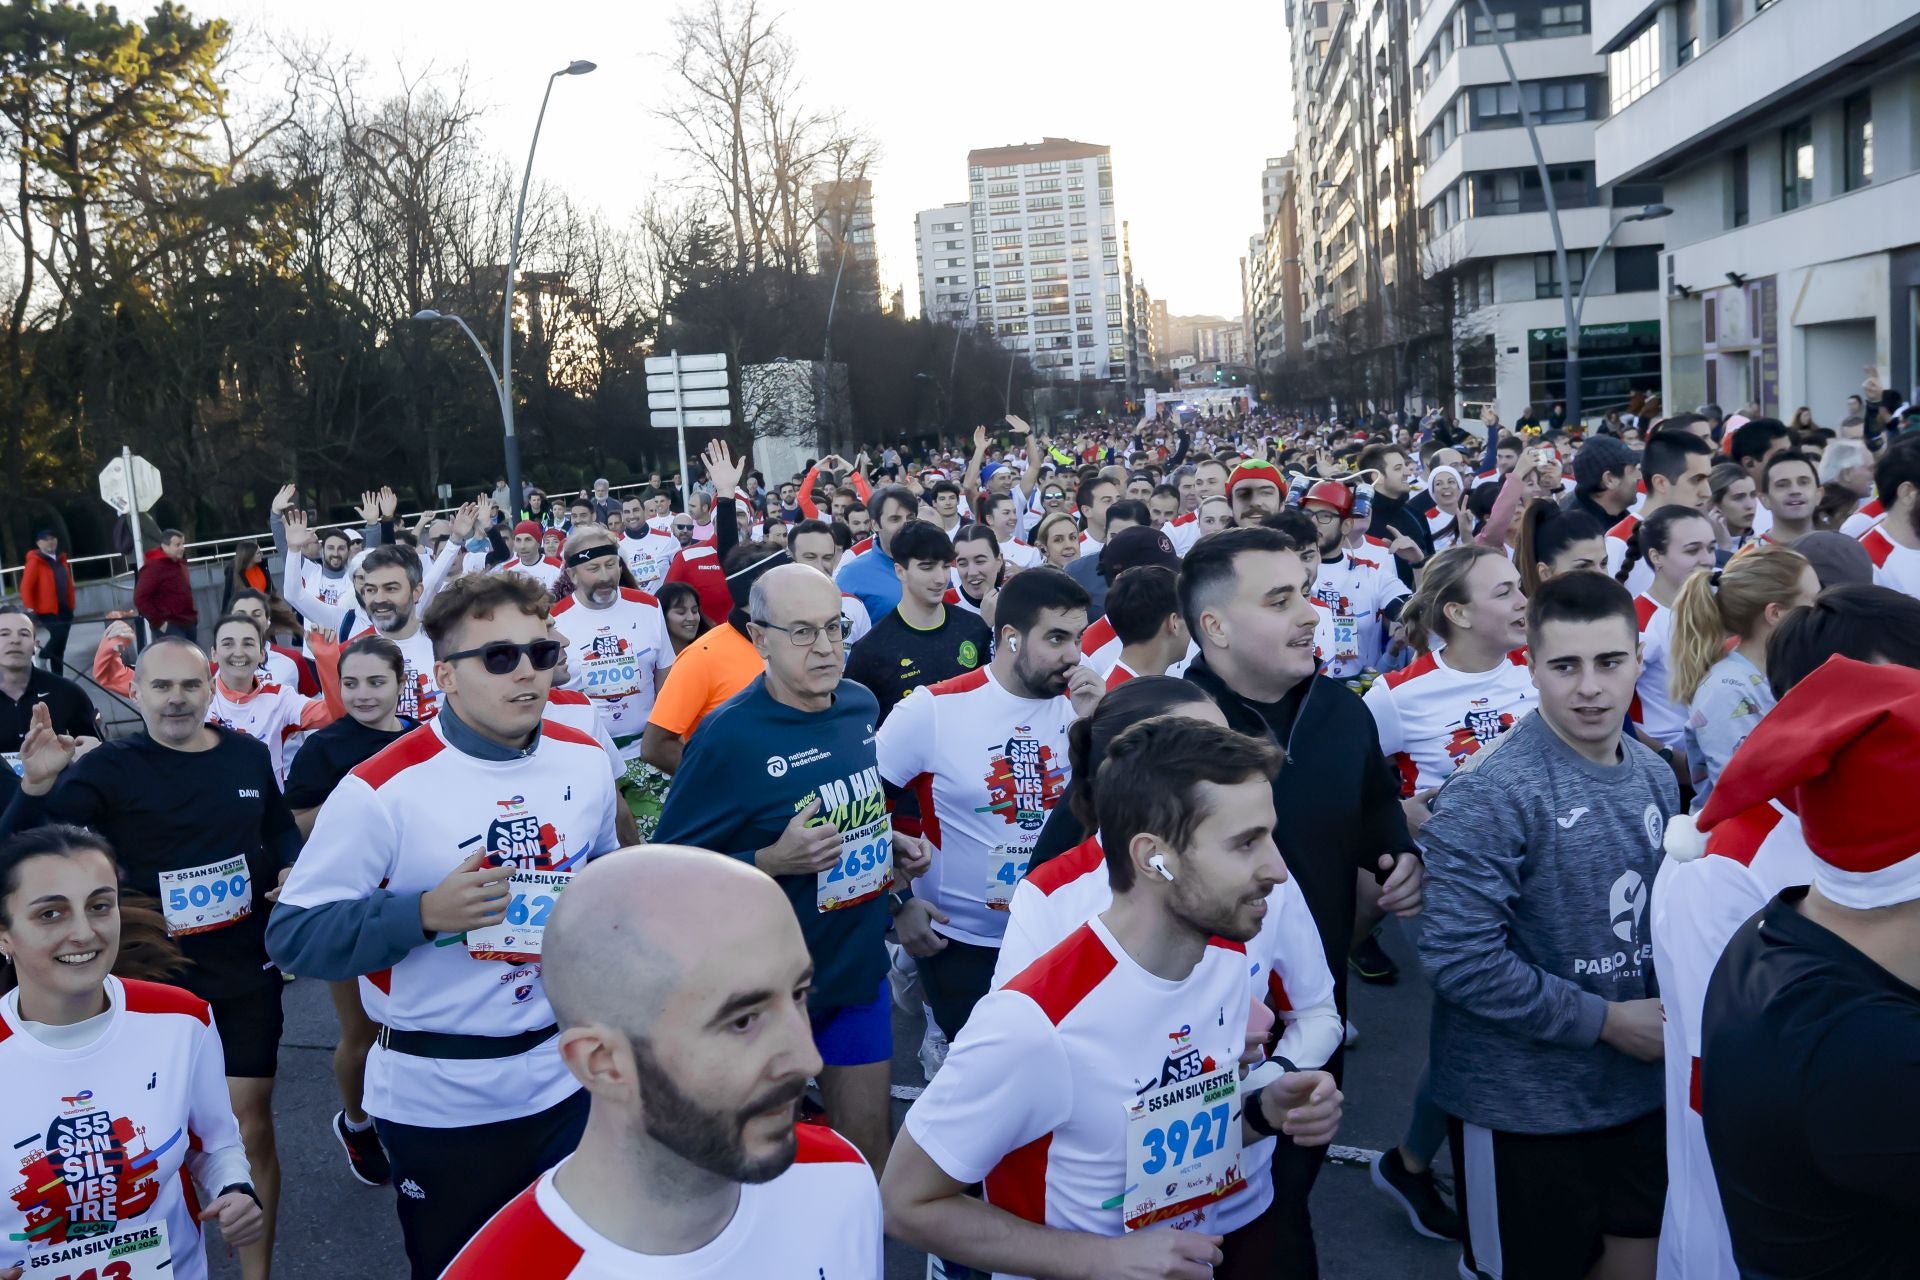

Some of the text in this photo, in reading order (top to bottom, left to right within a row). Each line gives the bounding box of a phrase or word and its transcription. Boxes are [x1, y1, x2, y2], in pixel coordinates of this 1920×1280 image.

[597, 645, 620, 655] SAN
[603, 636, 618, 647] 55
[587, 665, 635, 686] 2700
[788, 747, 819, 761] nationale
[1010, 749, 1040, 765] SAN
[1020, 740, 1039, 754] 55
[790, 750, 832, 768] nederlanden
[1012, 763, 1041, 780] SIL
[818, 779, 850, 813] NO
[1014, 778, 1043, 795] VES
[1014, 793, 1044, 812] TRE
[511, 818, 540, 842] 55
[844, 832, 860, 844] SAN
[496, 838, 542, 860] SAN
[826, 837, 888, 884] 2630
[177, 869, 189, 881] 55
[189, 869, 208, 879] SAN
[208, 858, 244, 875] SILVESTRE
[169, 874, 246, 912] 5090
[1179, 1051, 1204, 1081] 55
[1148, 1069, 1234, 1113] 55 SAN SILVESTRE
[75, 1114, 111, 1138] 55
[57, 1134, 112, 1158] SAN
[1142, 1102, 1230, 1175] 3927
[63, 1152, 114, 1182] SIL
[65, 1174, 118, 1203] VES
[65, 1195, 118, 1222] TRE
[31, 1226, 159, 1269] 55 SAN SILVESTRE
[138, 1238, 159, 1251] 2024
